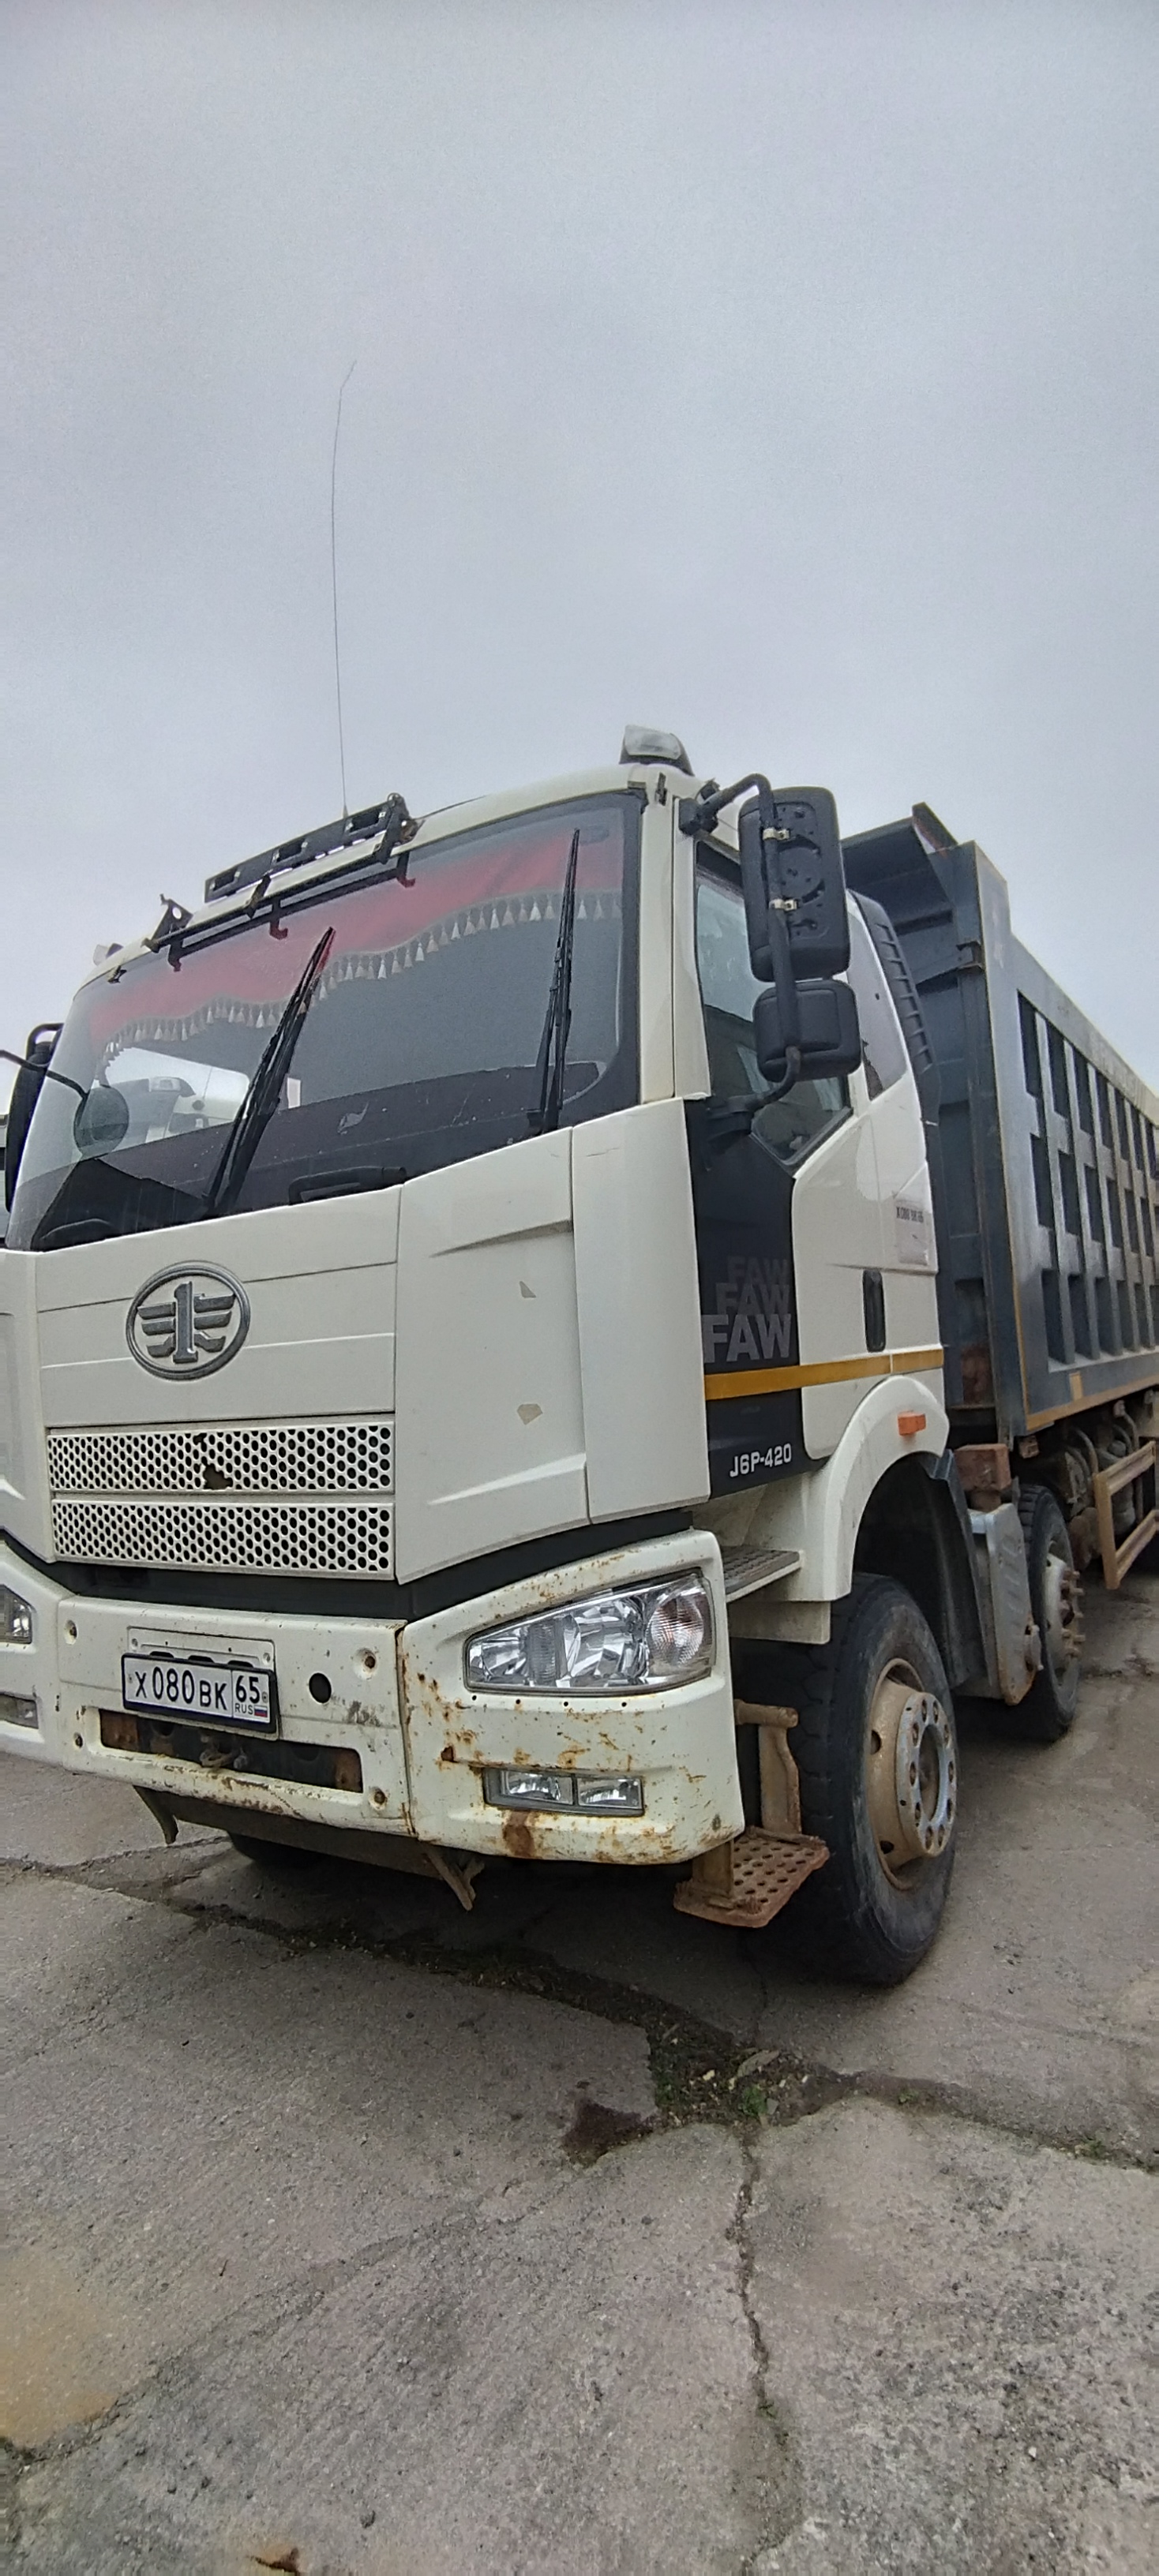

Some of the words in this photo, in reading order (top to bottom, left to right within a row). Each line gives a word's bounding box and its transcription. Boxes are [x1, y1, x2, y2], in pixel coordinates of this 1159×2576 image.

[727, 1256, 788, 1285] FAW
[715, 1282, 790, 1316] FAW
[702, 1313, 791, 1364] FAW
[730, 1443, 792, 1477] J6P-420
[236, 1675, 261, 1703] 65
[234, 1702, 253, 1715] RUS
